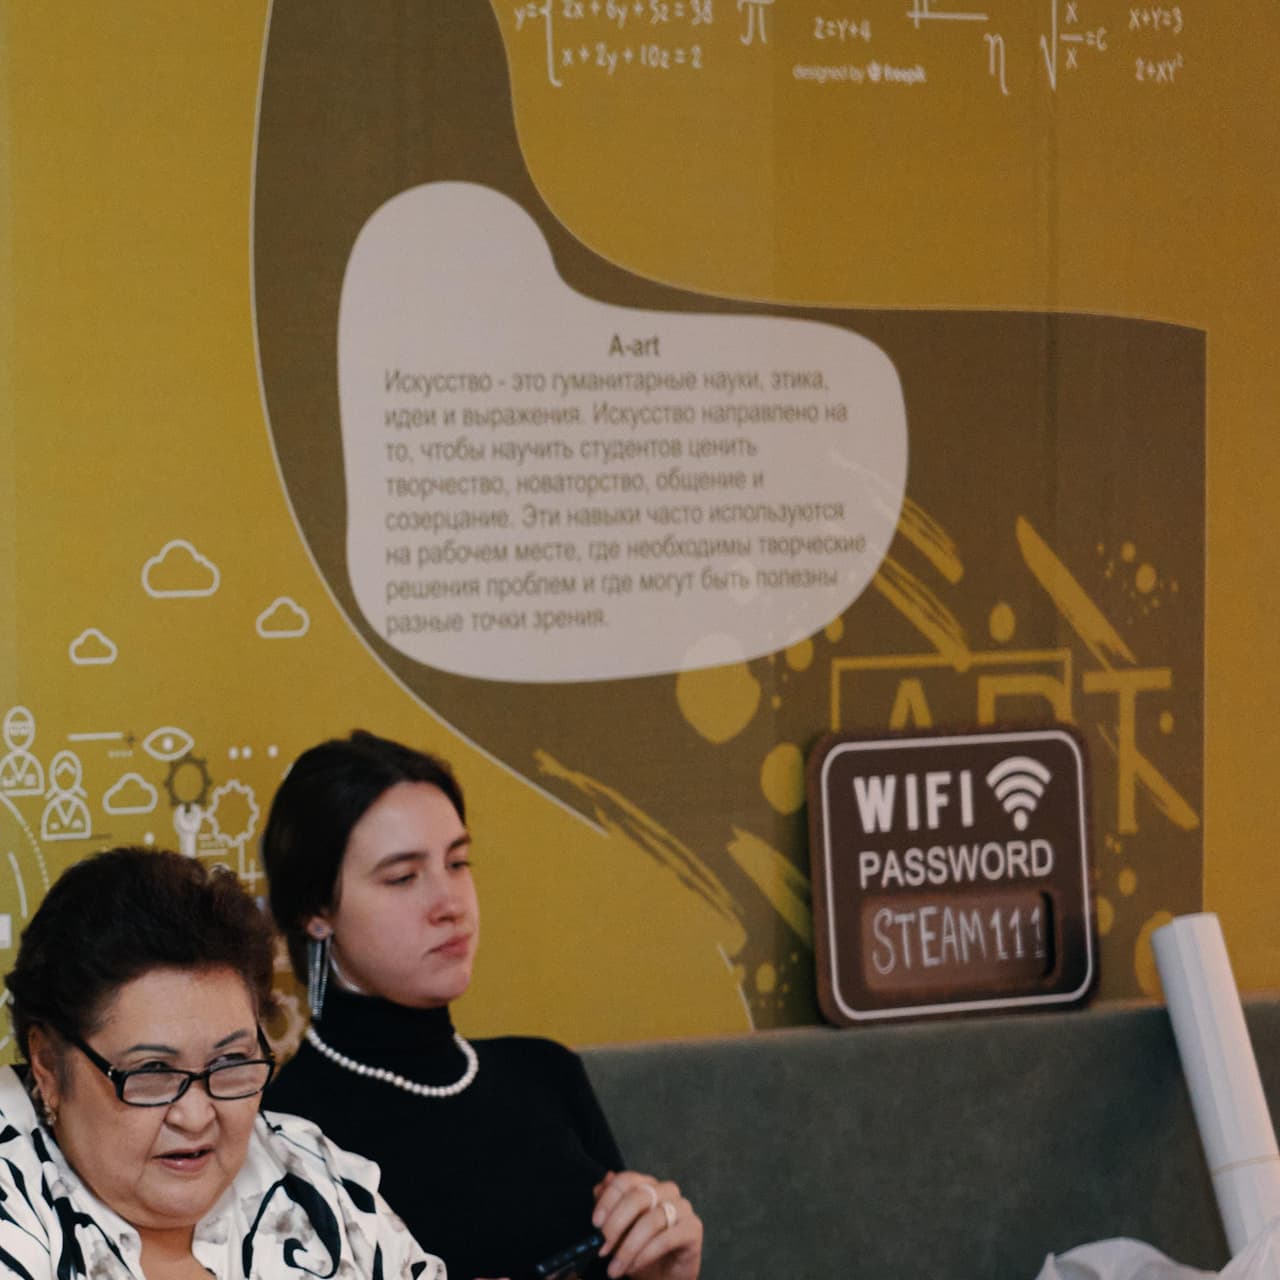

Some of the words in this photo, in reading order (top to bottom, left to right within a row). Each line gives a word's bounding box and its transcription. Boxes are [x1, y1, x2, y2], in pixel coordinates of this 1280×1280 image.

[606, 332, 662, 359] A-art
[383, 368, 494, 399] Искусство
[511, 372, 548, 393] это
[550, 370, 698, 399] гуманитарные
[702, 370, 765, 396] науки,
[770, 370, 830, 392] этика,
[383, 407, 438, 431] идеи
[442, 408, 457, 428] и
[461, 405, 585, 432] выражения.
[592, 399, 697, 432] Искусство
[701, 403, 820, 429] направлено
[824, 402, 849, 424] на
[384, 441, 415, 465] то,
[418, 435, 487, 463] чтобы
[490, 439, 575, 468] научить
[578, 437, 683, 466] студентов
[688, 436, 759, 460] ценить
[384, 475, 511, 503] творчество,
[515, 472, 651, 499] новаторство,
[655, 465, 747, 494] общение
[751, 470, 765, 490] и
[383, 509, 515, 536] созерцание.
[521, 503, 562, 530] Эти
[565, 507, 642, 527] навыки
[645, 504, 704, 526] часто
[708, 501, 846, 529] используются
[384, 545, 412, 566] на
[416, 538, 509, 571] рабочем
[514, 541, 583, 563] месте,
[587, 540, 621, 563] где
[626, 533, 753, 560] необходимы
[757, 533, 867, 560] творческие
[384, 577, 481, 606] решения
[486, 570, 578, 603] проблем
[581, 575, 597, 595] и
[600, 573, 634, 597] где
[638, 570, 696, 598] могут
[699, 565, 751, 592] быть
[755, 568, 839, 589] полезны
[383, 612, 465, 643] разные
[470, 610, 528, 632] точки
[532, 607, 609, 635] зрения.
[852, 769, 975, 834] WIFI
[858, 838, 1055, 890] PASSWORD
